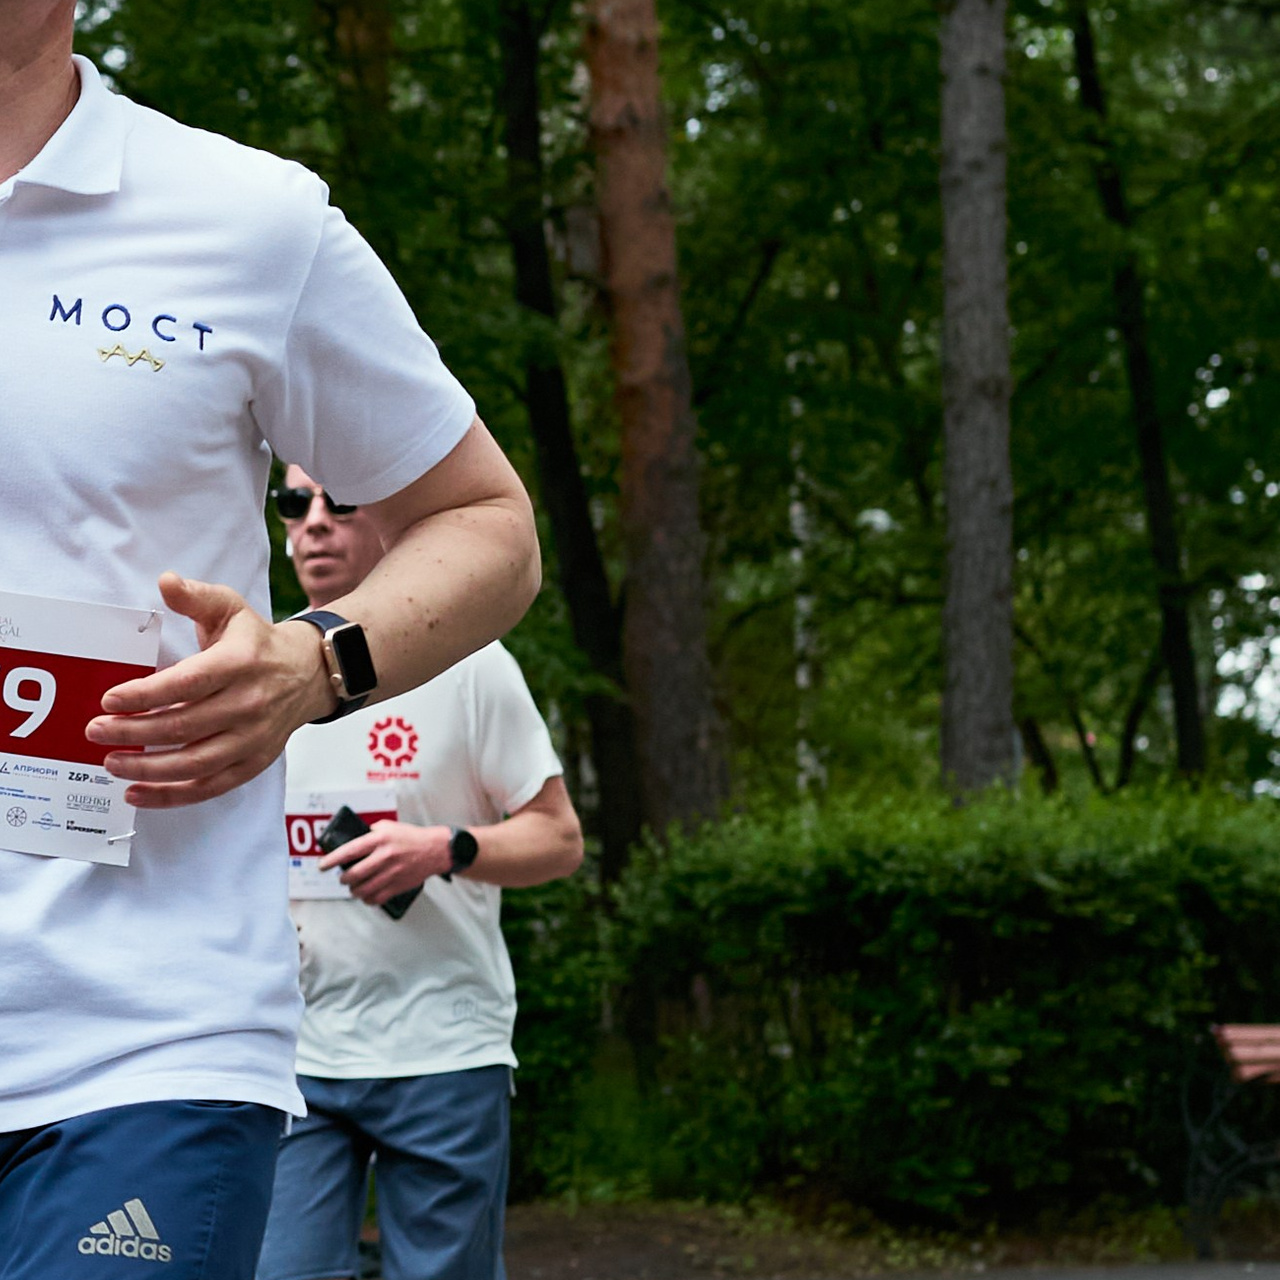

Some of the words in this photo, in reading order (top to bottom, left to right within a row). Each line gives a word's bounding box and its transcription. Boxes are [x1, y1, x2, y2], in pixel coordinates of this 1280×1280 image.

[49, 293, 213, 351] МОСТ
[13, 764, 59, 776] АПРИОРИ
[77, 1232, 173, 1263] adidas
